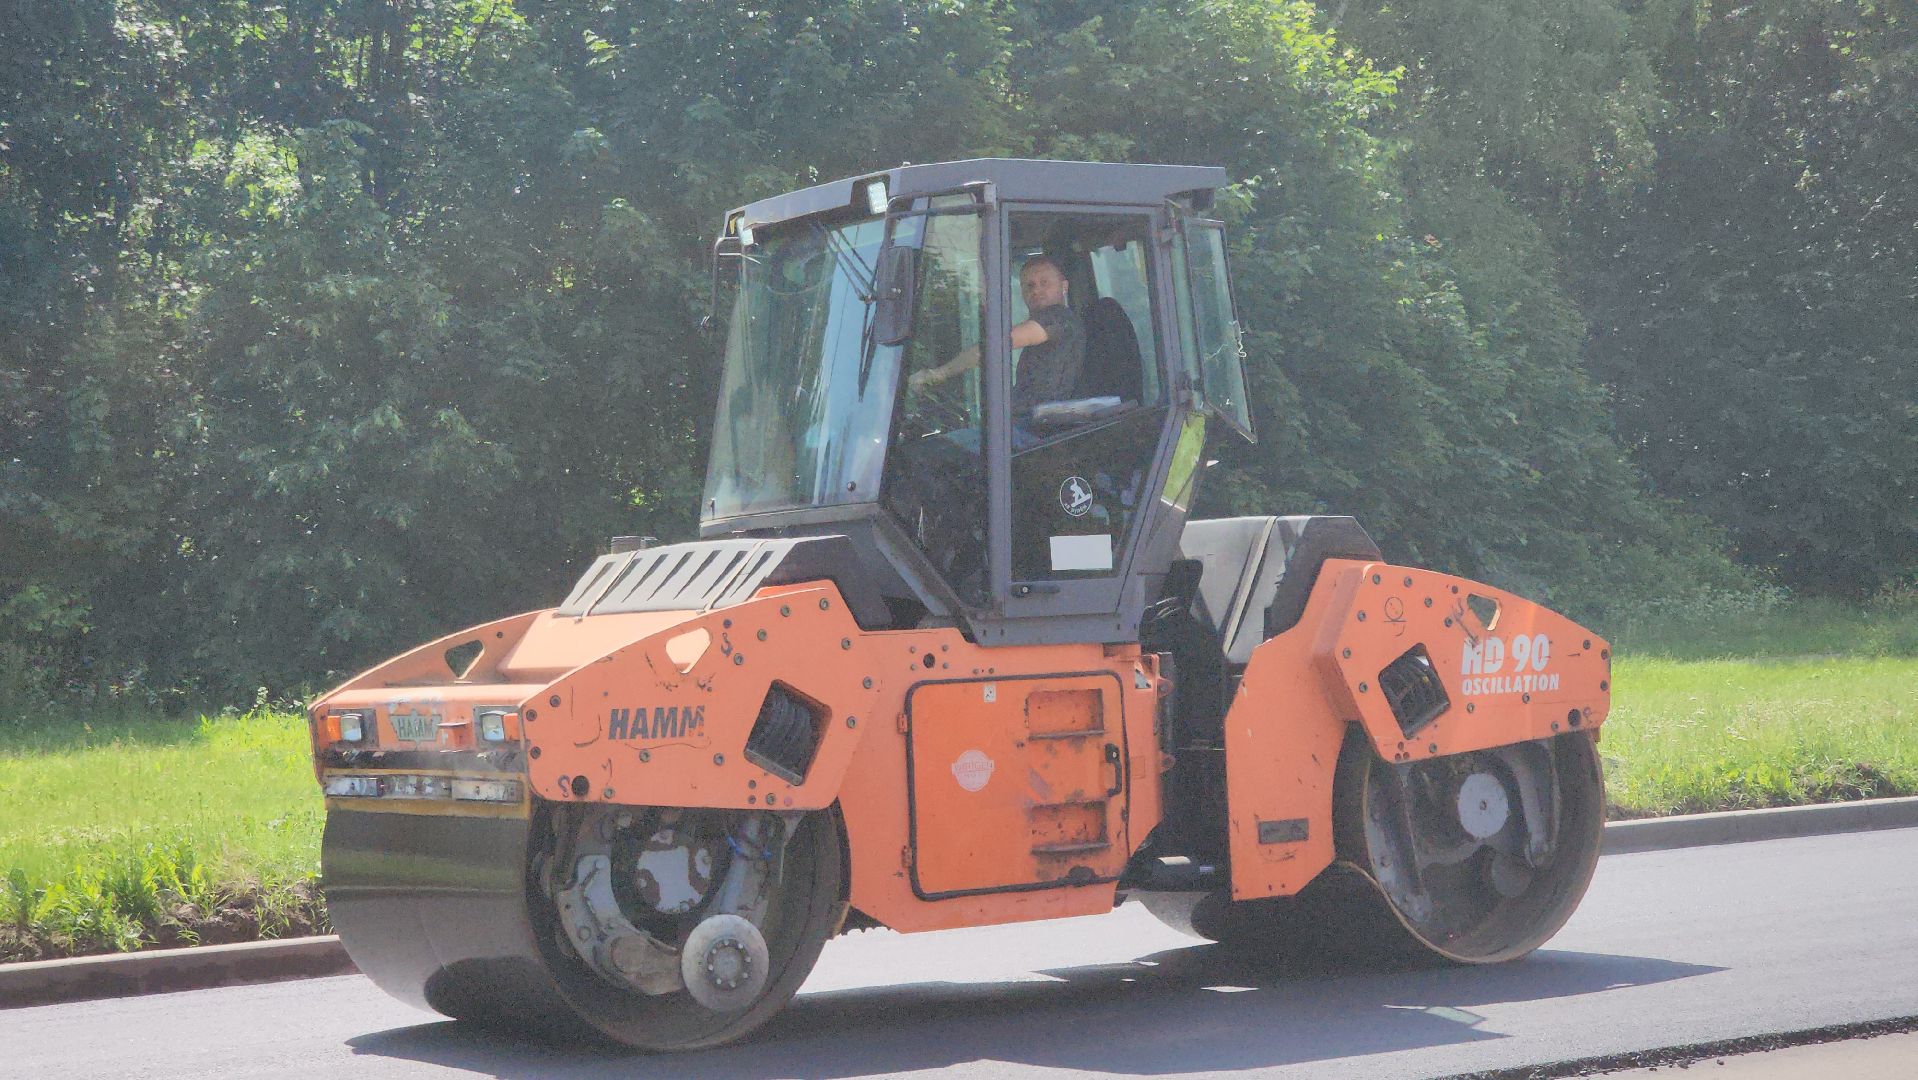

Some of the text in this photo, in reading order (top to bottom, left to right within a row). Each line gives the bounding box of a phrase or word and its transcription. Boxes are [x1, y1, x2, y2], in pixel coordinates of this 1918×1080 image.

[1512, 634, 1550, 672] 90
[1462, 673, 1559, 696] OSCILLATION
[608, 705, 705, 740] HAMM
